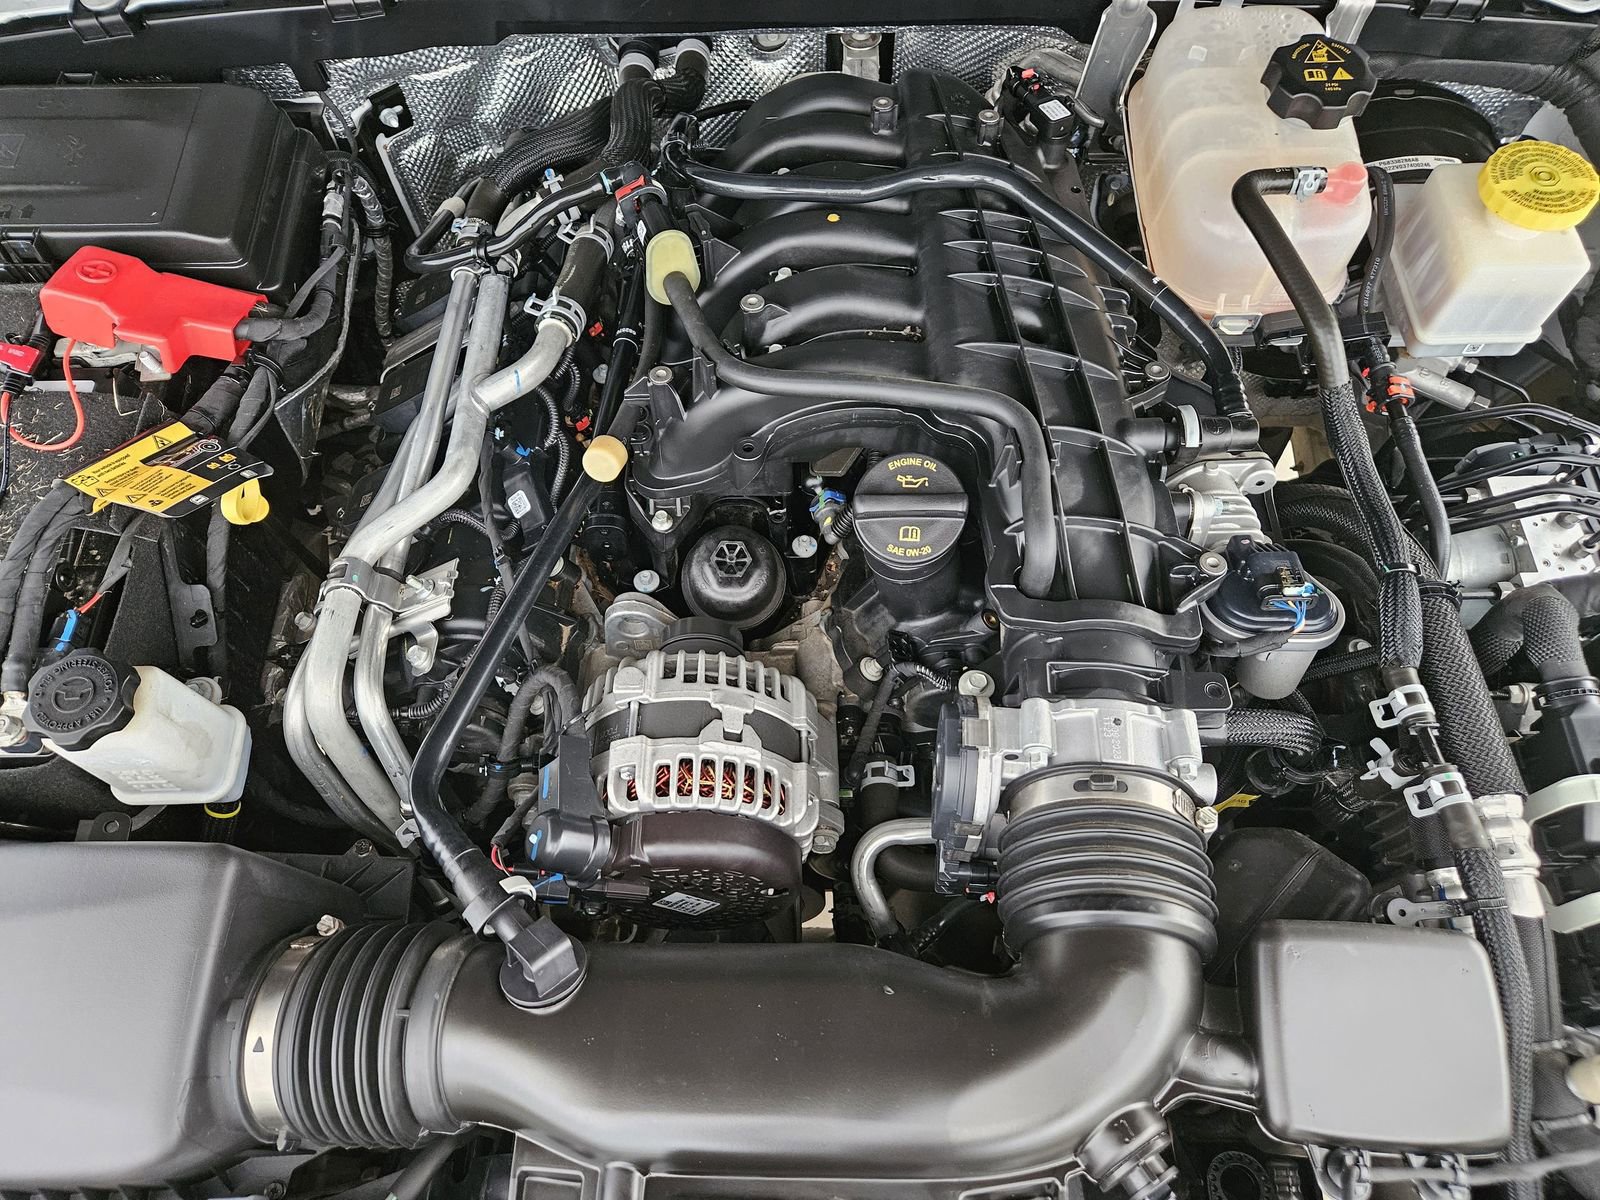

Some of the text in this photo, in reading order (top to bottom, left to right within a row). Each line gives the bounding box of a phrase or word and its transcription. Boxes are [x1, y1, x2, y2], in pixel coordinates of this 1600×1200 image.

[888, 458, 938, 472] ENGINE OIL
[886, 544, 932, 556] SAE 0W-20
[53, 658, 99, 675] STEERING
[96, 662, 113, 693] POWER
[36, 706, 104, 730] USE APPROVED
